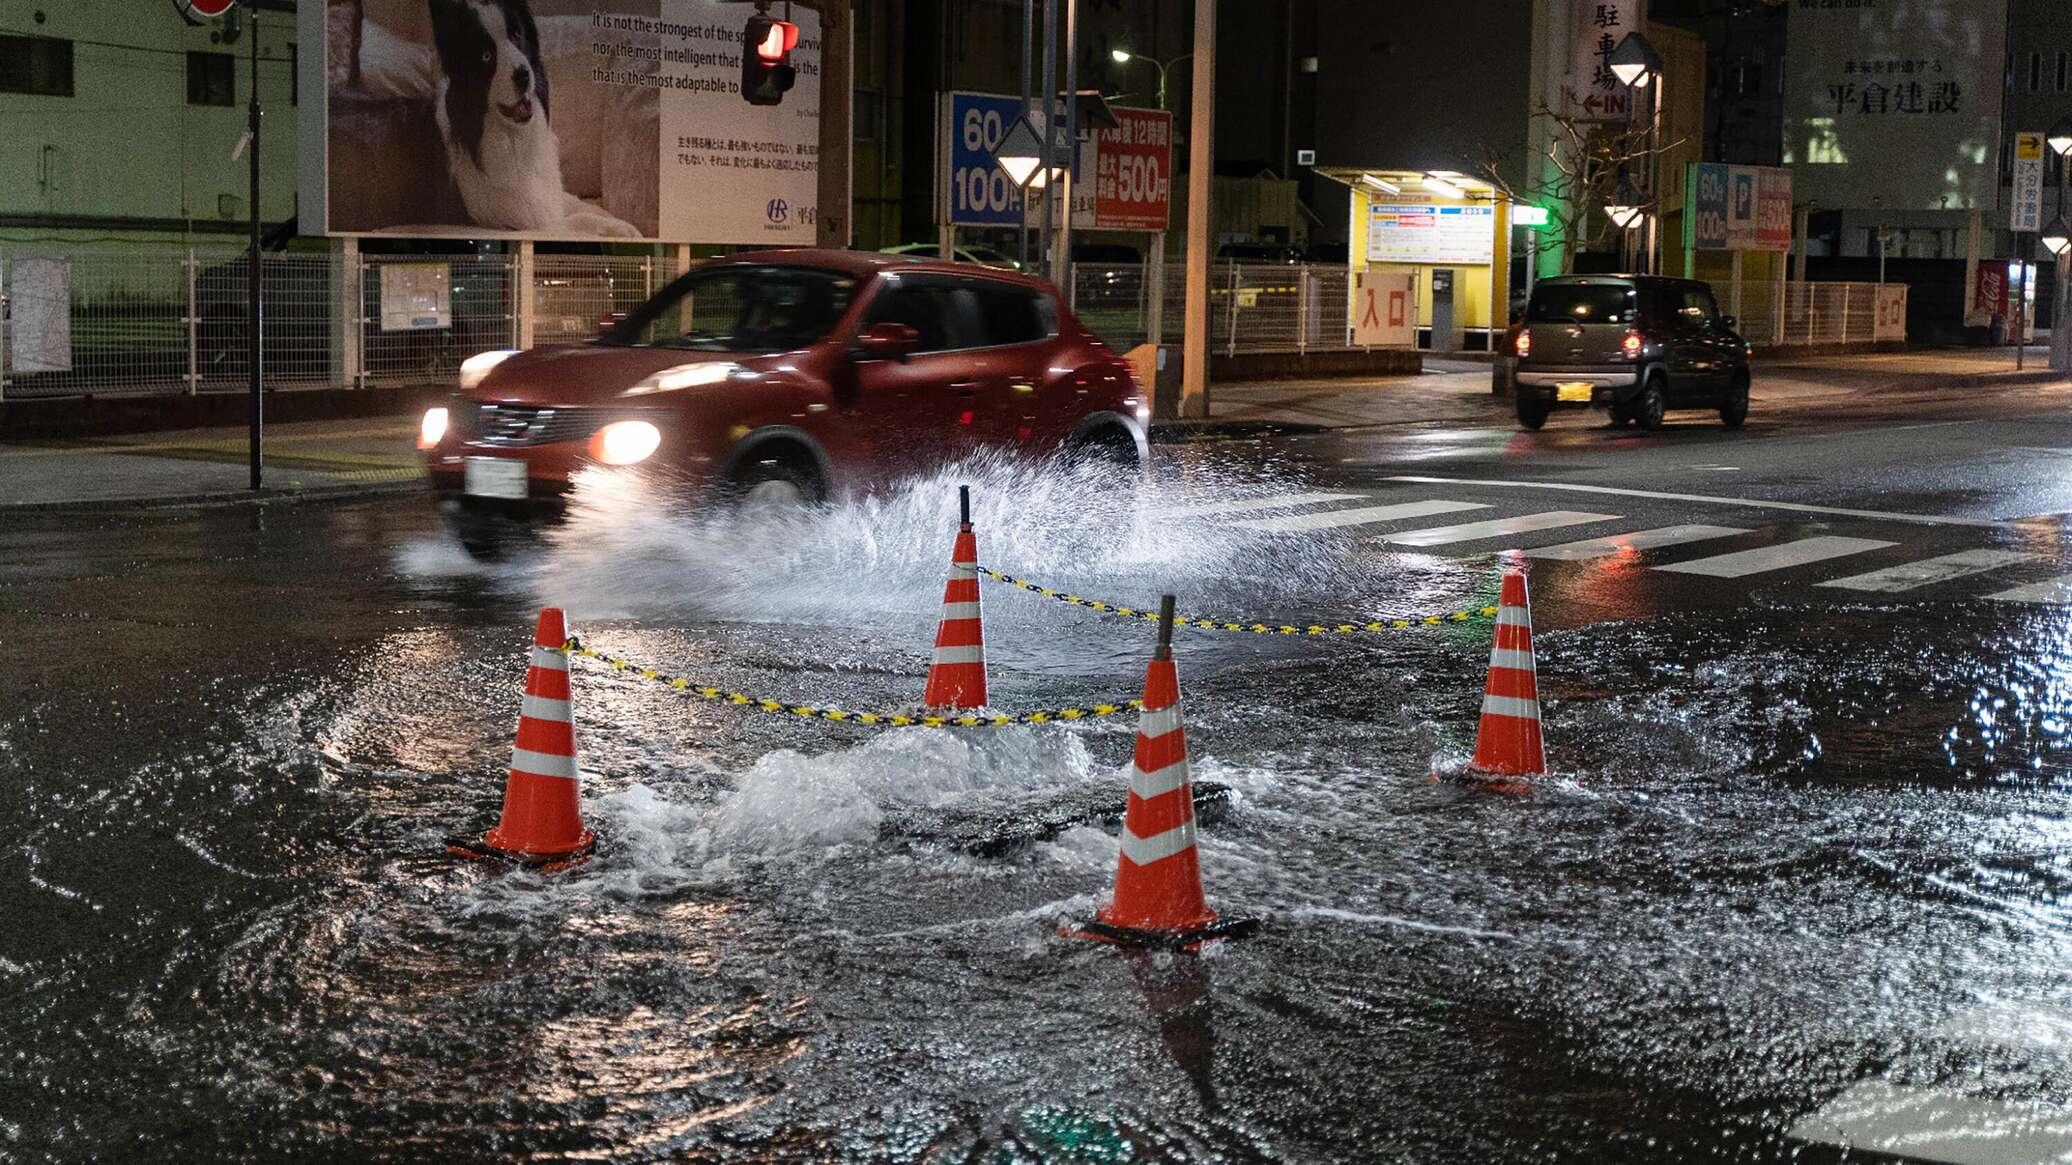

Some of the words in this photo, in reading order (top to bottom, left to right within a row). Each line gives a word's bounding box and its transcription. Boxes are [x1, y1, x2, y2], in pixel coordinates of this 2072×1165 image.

[593, 12, 600, 27] It
[603, 12, 611, 28] is
[614, 18, 632, 31] not
[634, 17, 652, 32] the
[654, 21, 702, 40] strongest
[704, 25, 715, 39] of
[717, 26, 736, 42] the
[593, 42, 610, 55] nor
[616, 42, 633, 57] the
[636, 47, 661, 60] most
[664, 47, 716, 68] intelligent
[719, 52, 739, 67] that
[803, 61, 818, 75] the
[1593, 4, 1620, 91] 駐車場
[593, 67, 614, 82] that
[617, 70, 625, 83] is
[628, 69, 645, 85] the
[647, 74, 673, 88] most
[675, 74, 727, 94] adaptable
[728, 81, 739, 93] to
[1603, 95, 1625, 113] IN
[1827, 81, 1960, 114] 平倉建設
[964, 108, 1005, 153] 60
[1118, 155, 1168, 203] 500円
[1739, 182, 1749, 211] P
[1362, 288, 1405, 328] 入口
